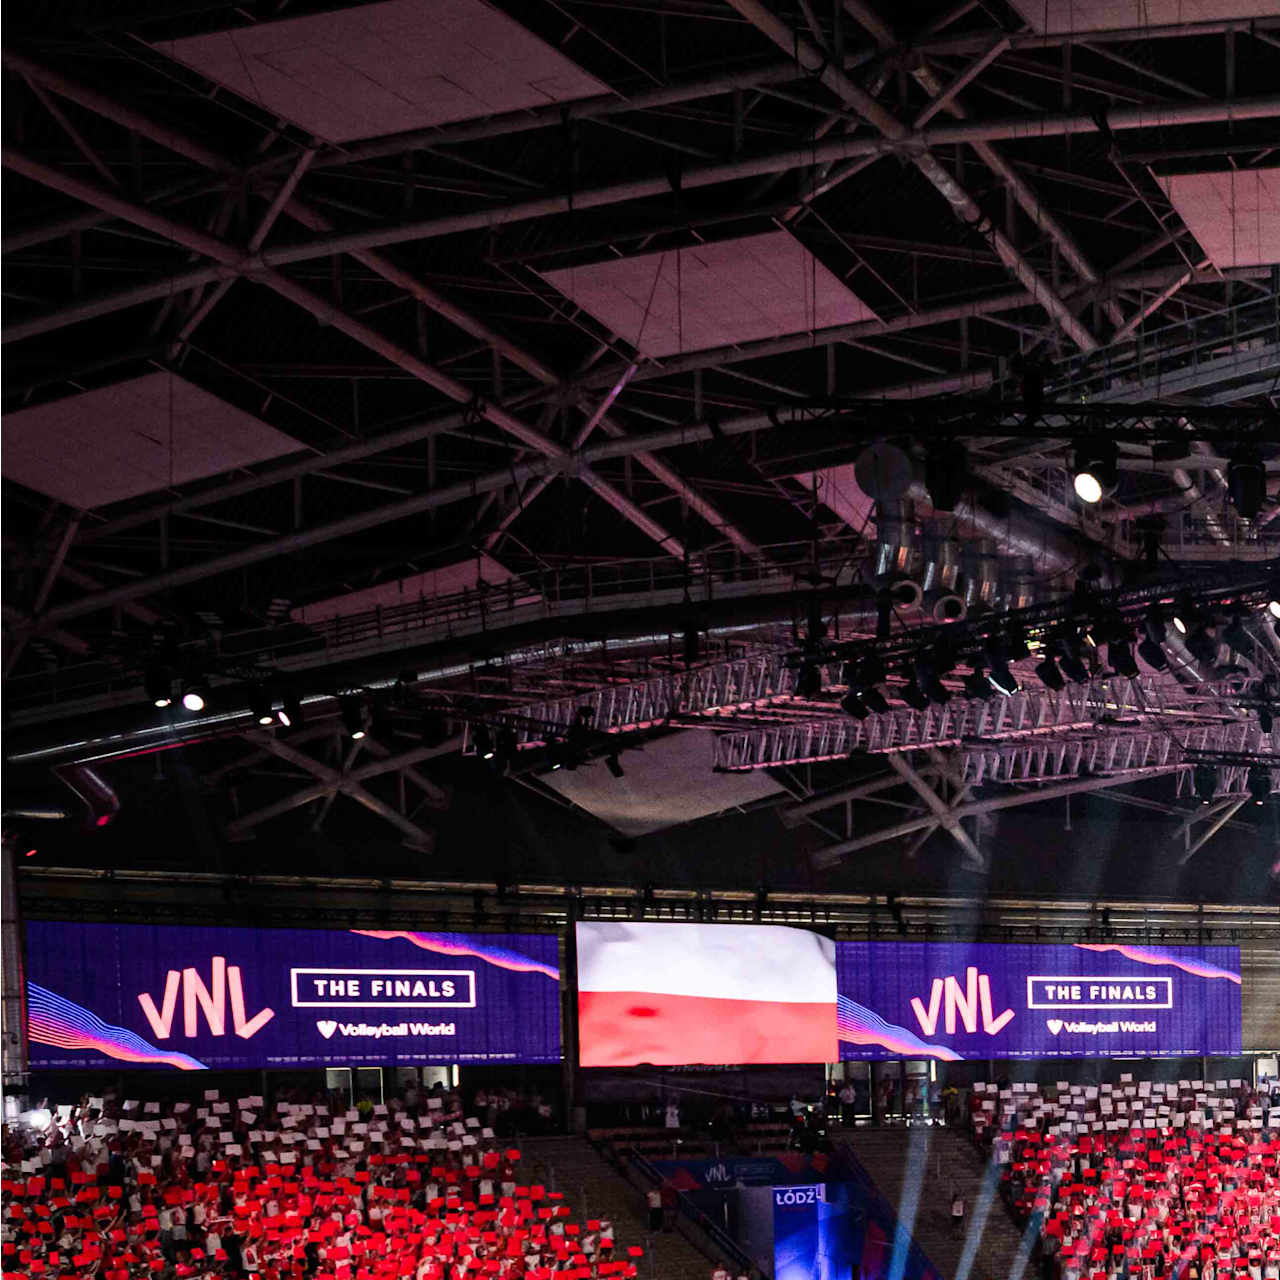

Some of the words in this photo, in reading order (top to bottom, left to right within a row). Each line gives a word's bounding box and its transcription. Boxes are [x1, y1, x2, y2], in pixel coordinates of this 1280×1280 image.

[138, 956, 275, 1039] VNL
[314, 979, 362, 998] THE
[370, 980, 456, 998] FINALS
[1045, 985, 1082, 1000] THE
[1089, 986, 1157, 1001] FINALS
[911, 966, 1016, 1036] VNL
[339, 1021, 408, 1039] Volleyball
[410, 1021, 456, 1037] World
[1064, 1020, 1119, 1036] Volleyball
[1120, 1020, 1157, 1034] World
[776, 1189, 815, 1205] ŁÓDŹ
